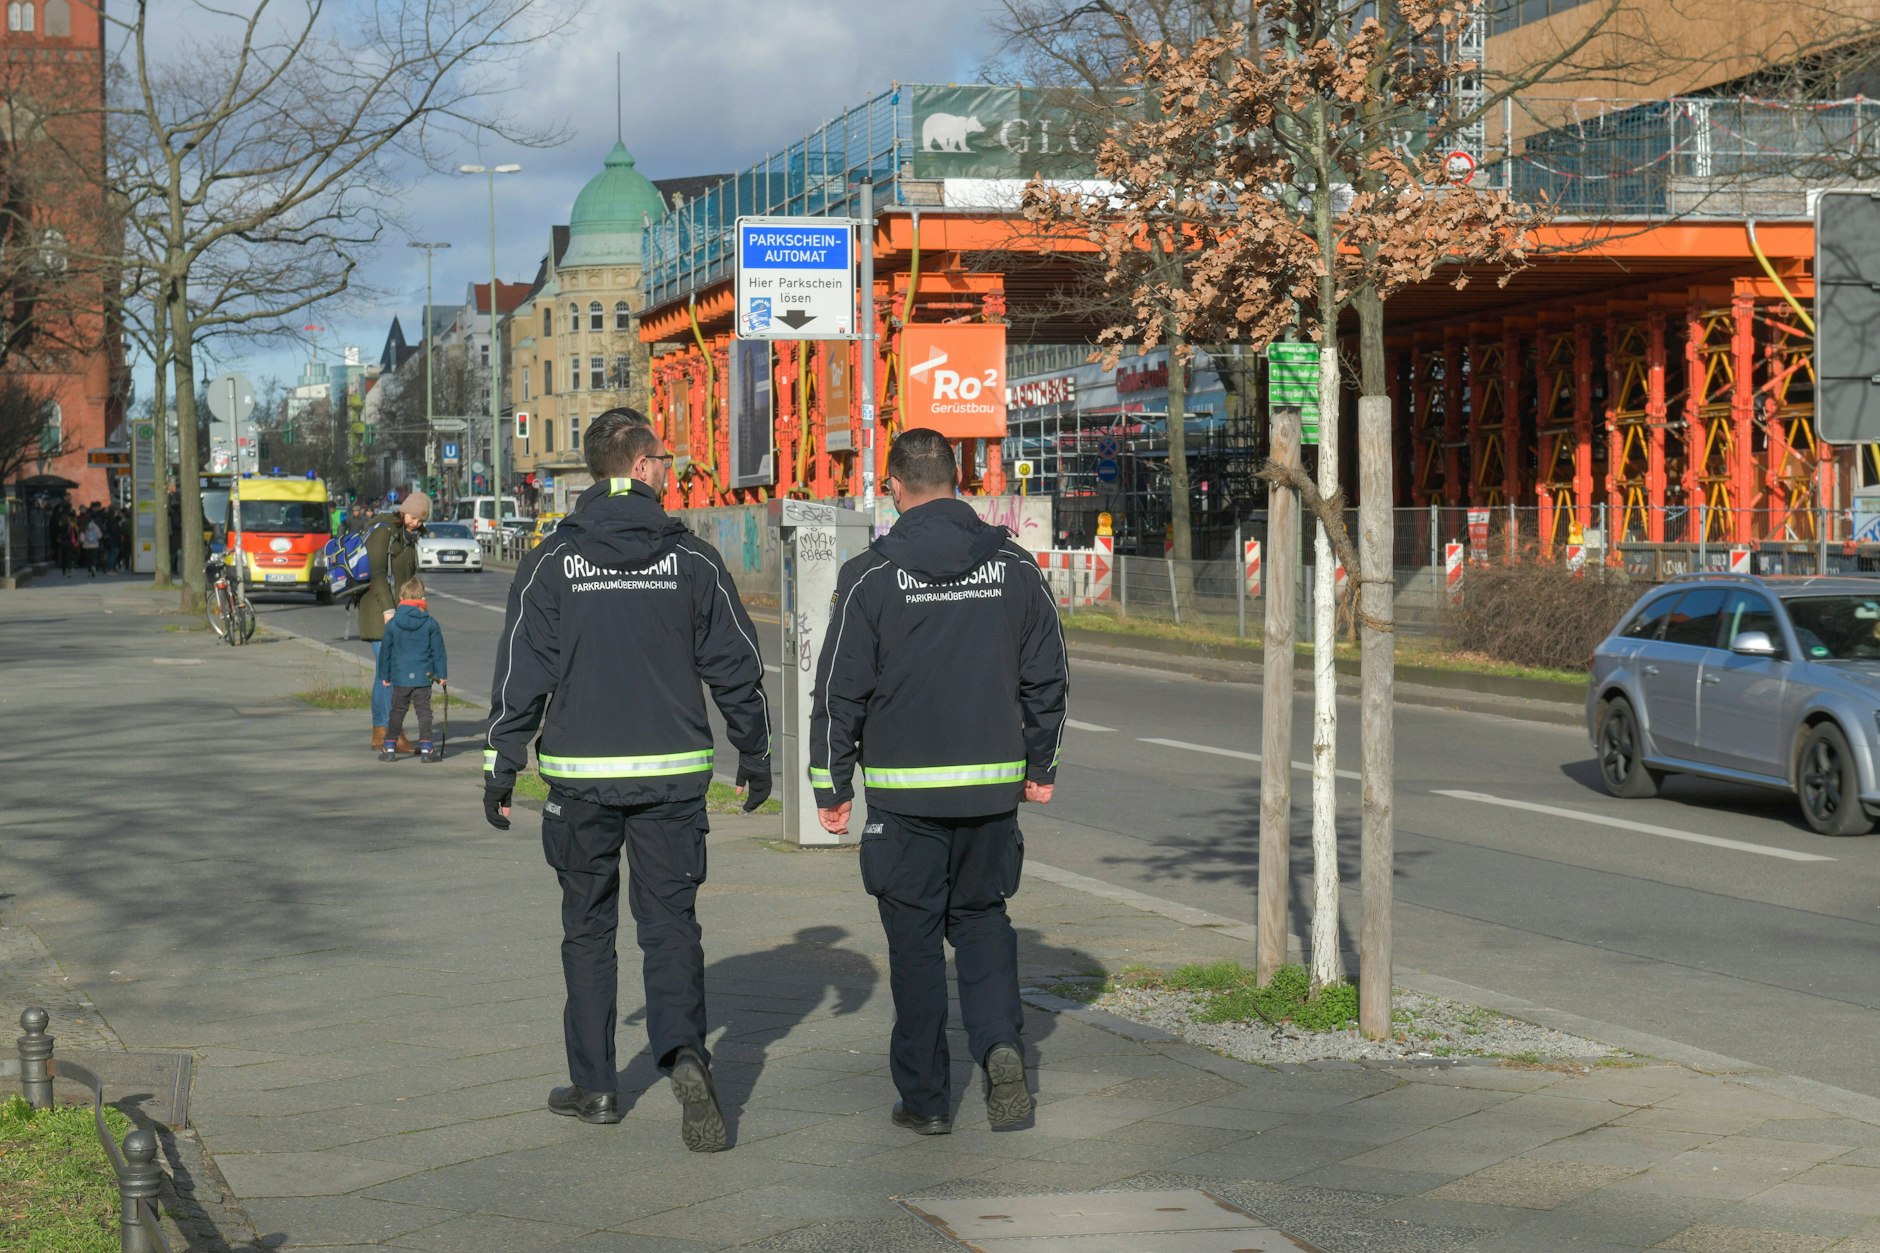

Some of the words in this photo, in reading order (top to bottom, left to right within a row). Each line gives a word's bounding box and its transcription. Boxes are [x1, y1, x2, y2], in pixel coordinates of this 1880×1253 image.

[749, 233, 842, 247] PARKSCHEIN-
[764, 249, 828, 263] AUTOMAT
[749, 277, 774, 288] Hier
[779, 277, 843, 289] Parkschein
[780, 292, 812, 303] lösen
[930, 402, 995, 414] Gerüstbau
[445, 444, 456, 457] U
[563, 553, 678, 578] ORDAMT
[896, 560, 1007, 590] ORSAMT
[571, 579, 678, 593] PARKRAUMÜBERWACHUNG
[905, 588, 1003, 604] PARKRAUMÜBERWACHUN
